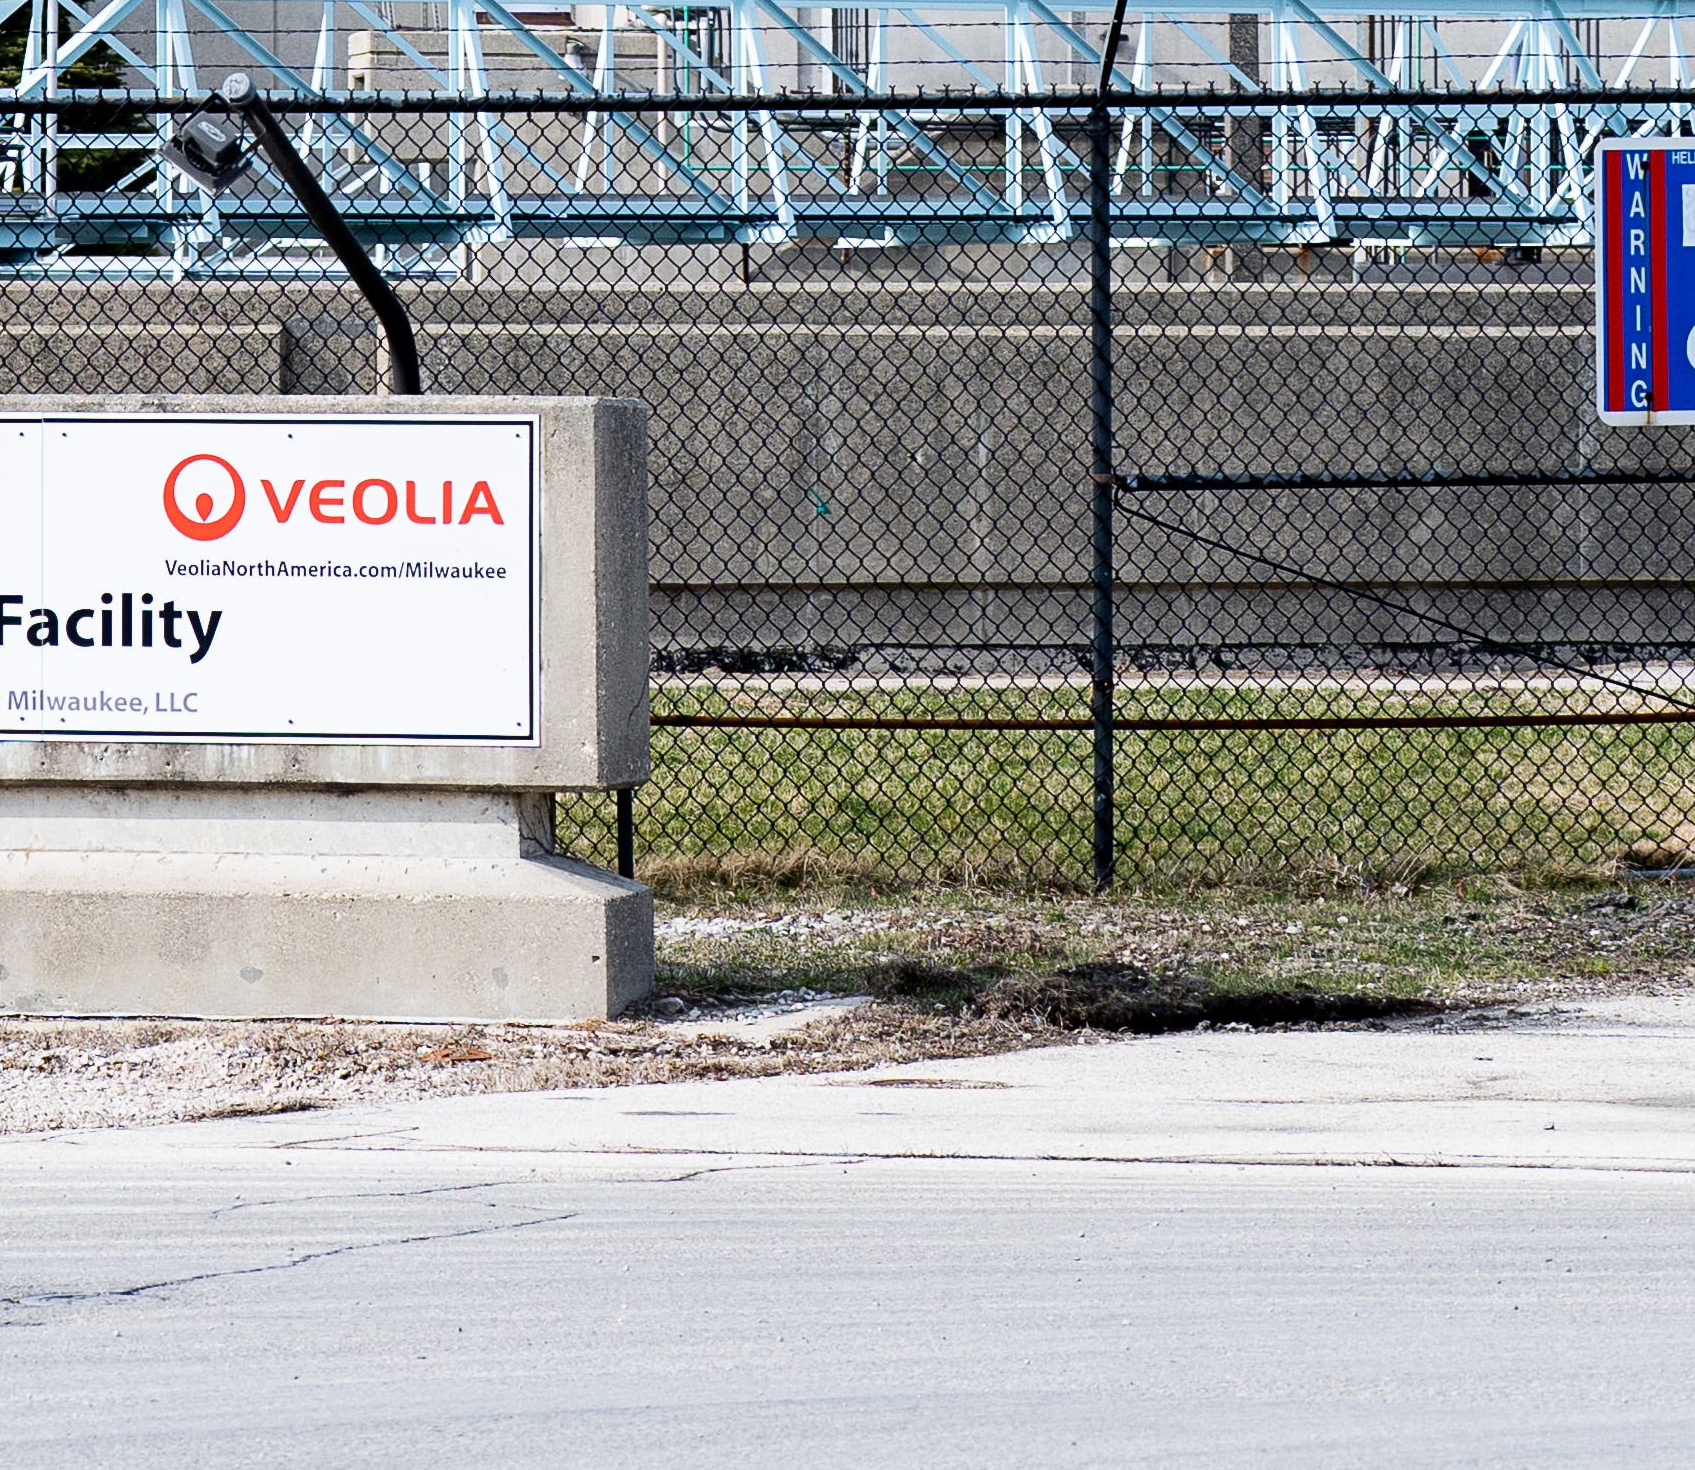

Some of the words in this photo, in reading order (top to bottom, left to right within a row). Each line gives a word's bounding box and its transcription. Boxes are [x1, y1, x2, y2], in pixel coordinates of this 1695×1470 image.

[1626, 154, 1647, 407] WARNING
[261, 479, 504, 525] VEOLIA
[166, 560, 506, 578] VeoliaNorthAmerica.com/Milwaukee
[8, 689, 148, 714] Milwaukee,
[156, 693, 197, 712] LLC
